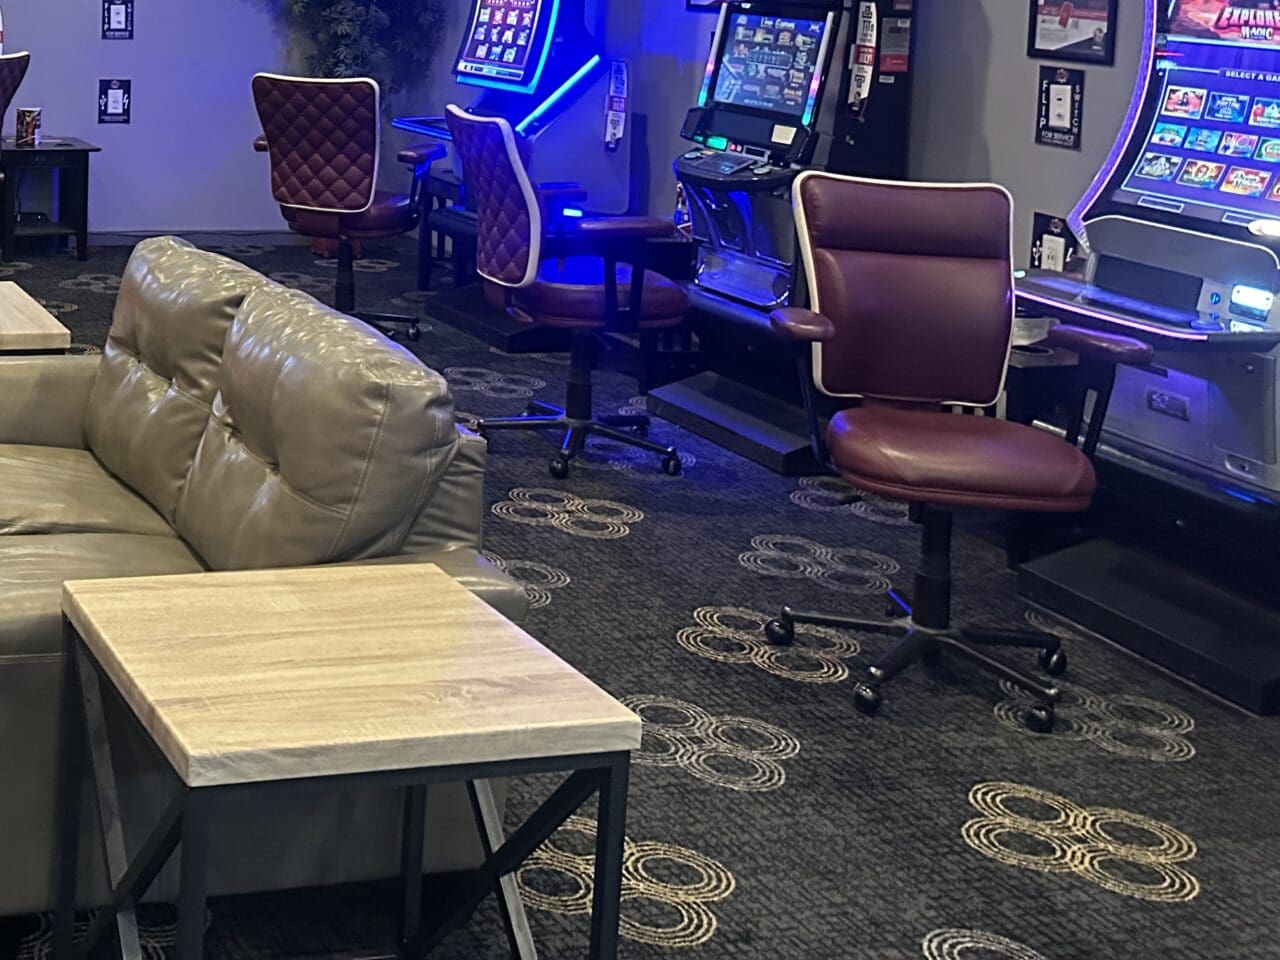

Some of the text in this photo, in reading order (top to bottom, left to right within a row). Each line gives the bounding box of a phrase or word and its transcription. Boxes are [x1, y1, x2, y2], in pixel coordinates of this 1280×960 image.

[1225, 70, 1255, 79] SELECT
[1039, 80, 1049, 128] FLIP
[1072, 84, 1081, 134] SWITCH
